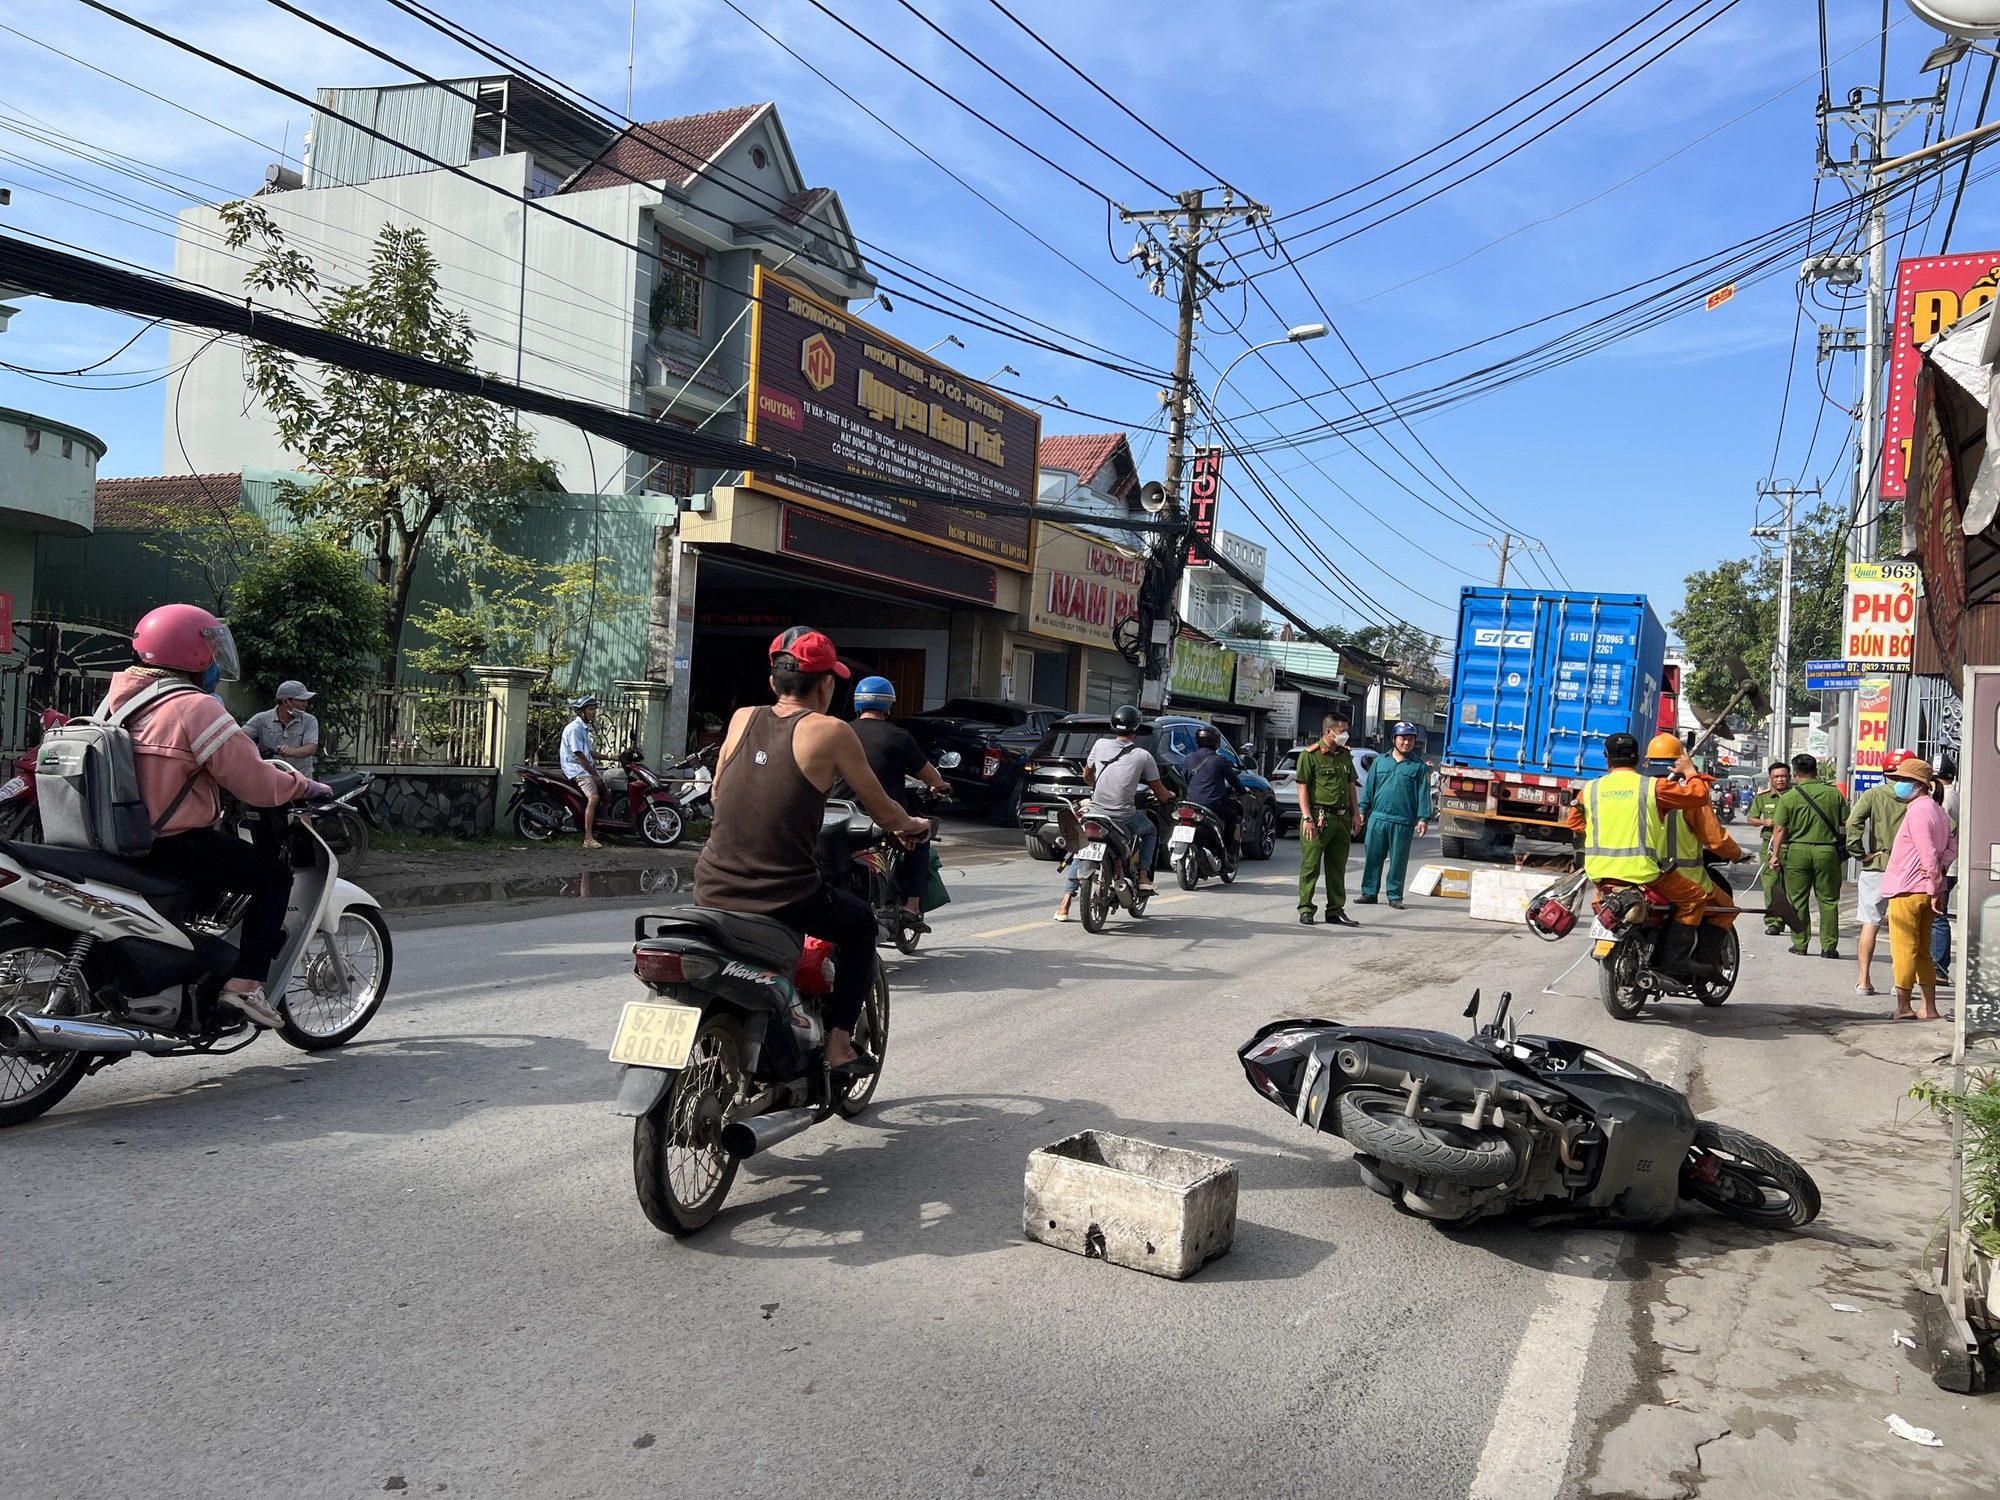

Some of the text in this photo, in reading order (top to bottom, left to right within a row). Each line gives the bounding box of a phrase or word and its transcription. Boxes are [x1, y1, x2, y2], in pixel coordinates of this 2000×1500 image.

[788, 296, 846, 334] SHOWROOM
[1187, 450, 1220, 564] HOTEL
[1087, 547, 1141, 585] HOTEL
[1854, 565, 1915, 578] Quán 963
[1047, 570, 1140, 629] NAM PH
[1852, 582, 1914, 623] PHỞ
[1477, 633, 1530, 645] SITC
[1570, 632, 1589, 642] SITU
[1597, 634, 1624, 645] 270965
[1595, 644, 1613, 655] 22G1
[1850, 628, 1911, 657] BÚN BÒ
[1847, 663, 1859, 672] ĐT:
[1859, 719, 1887, 742] PH
[623, 1035, 681, 1064] 8060
